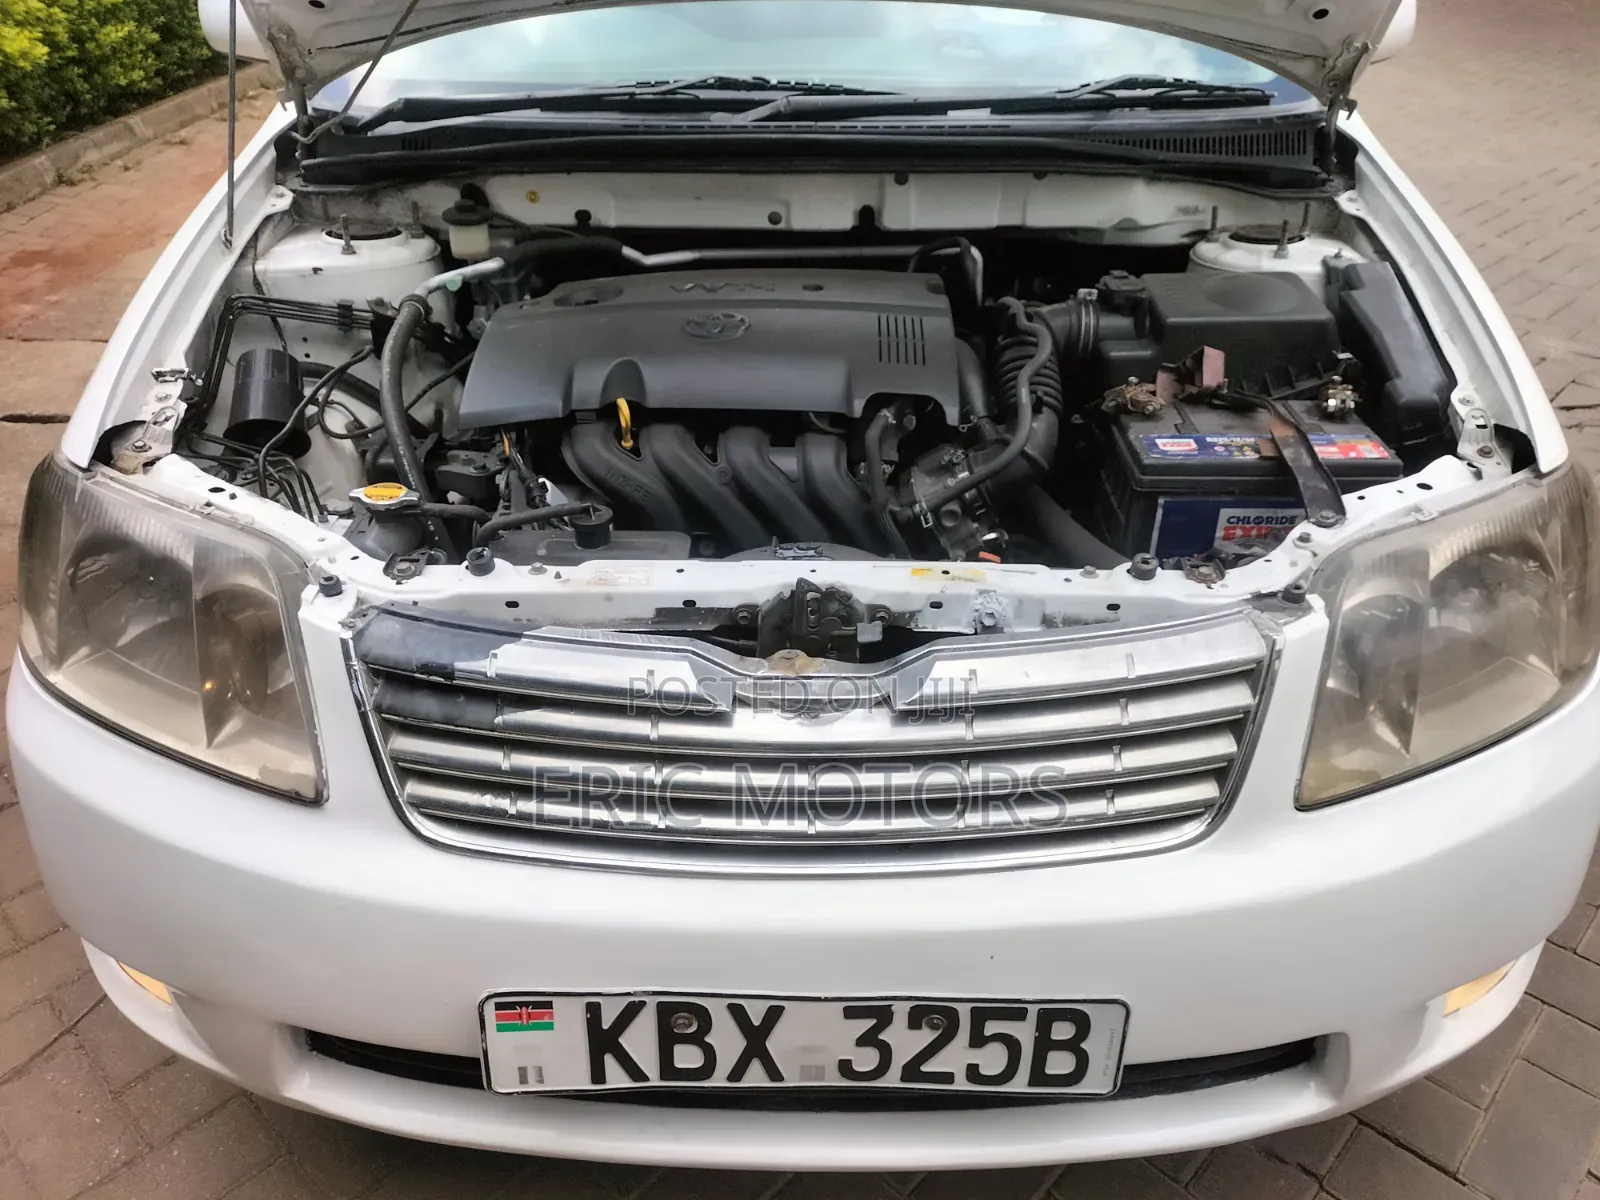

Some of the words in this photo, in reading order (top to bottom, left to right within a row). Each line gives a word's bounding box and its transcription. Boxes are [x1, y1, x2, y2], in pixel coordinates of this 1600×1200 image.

[1226, 515, 1298, 525] CHLORIDE
[585, 1001, 785, 1085] KBX
[837, 1005, 1092, 1088] 325B
